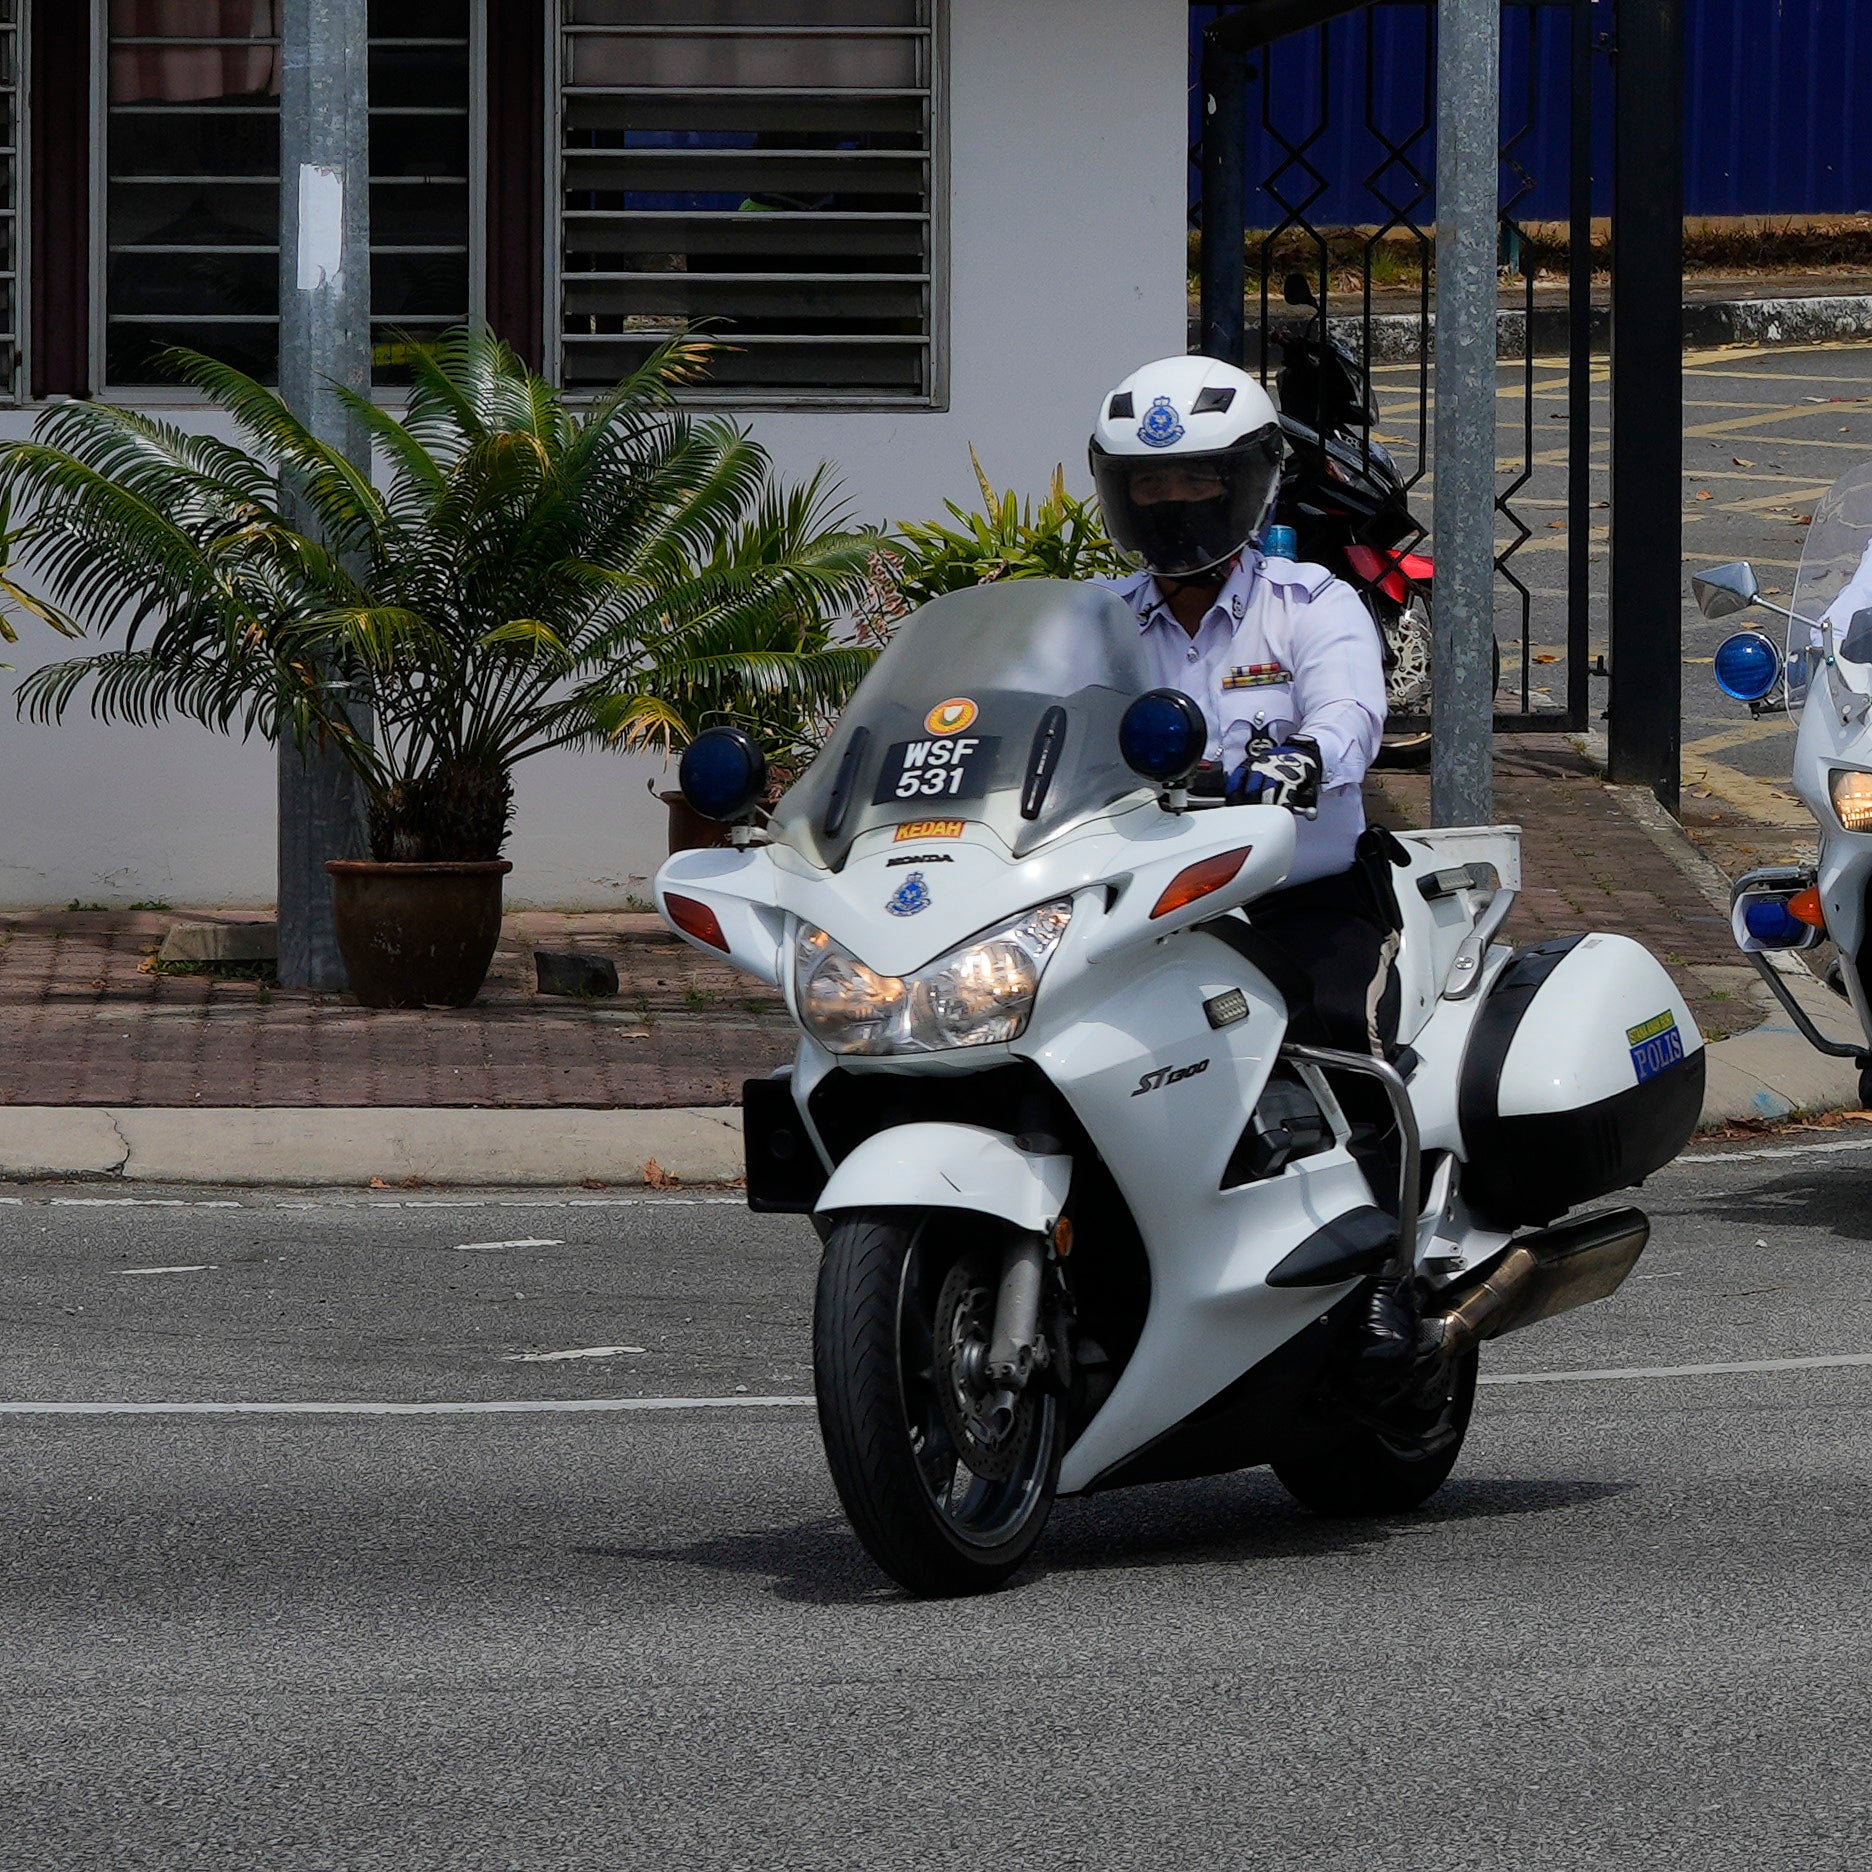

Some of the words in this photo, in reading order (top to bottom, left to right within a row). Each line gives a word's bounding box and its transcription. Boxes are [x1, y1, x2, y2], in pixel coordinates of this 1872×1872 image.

[902, 739, 980, 769] WSF
[895, 767, 965, 799] 531
[896, 821, 962, 840] KEDAH
[1634, 1031, 1682, 1078] POLIS
